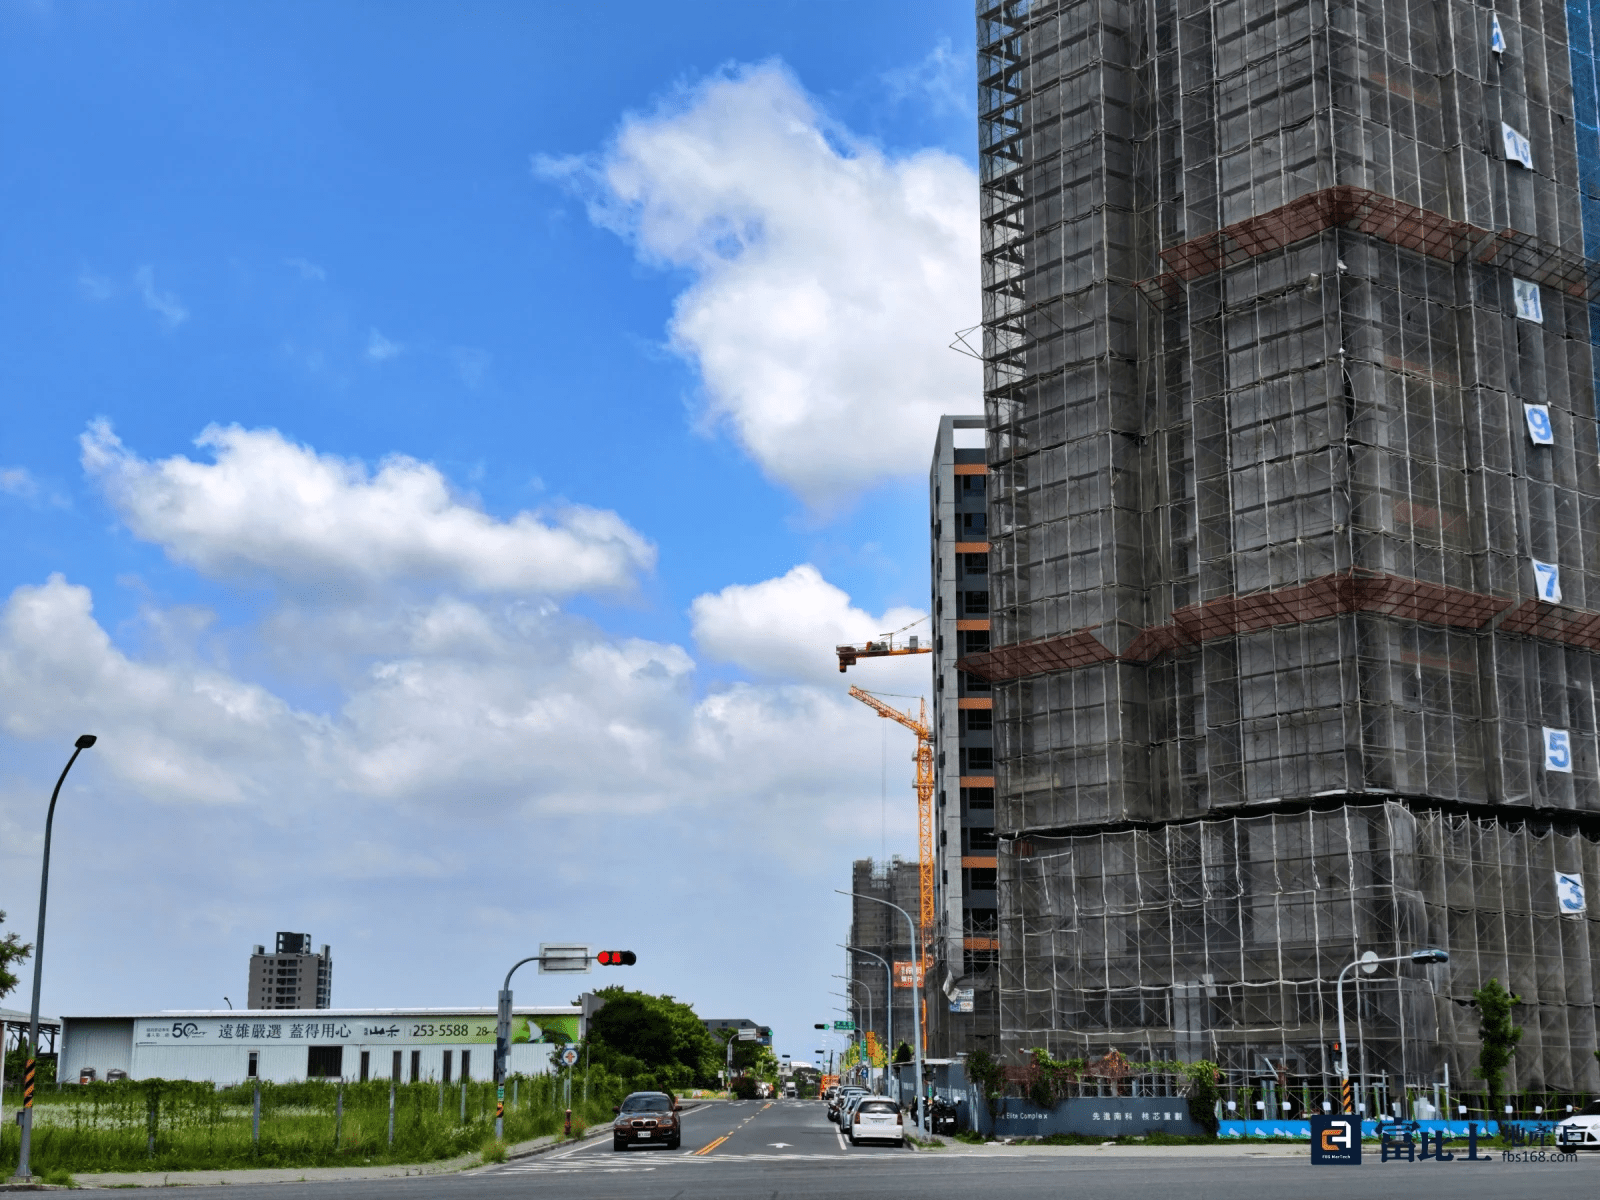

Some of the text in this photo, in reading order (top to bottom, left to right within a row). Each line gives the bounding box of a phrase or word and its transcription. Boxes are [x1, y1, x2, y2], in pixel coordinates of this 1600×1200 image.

[1516, 283, 1541, 319] 11
[1527, 407, 1552, 441] 9
[1535, 563, 1558, 598] 7
[1548, 732, 1570, 768] 5
[1560, 875, 1583, 910] 3
[172, 1022, 198, 1038] 50
[218, 1023, 282, 1039] 遠雄嚴選
[289, 1023, 352, 1039] 蓋得用心
[412, 1024, 469, 1037] 253-5588
[1020, 1112, 1048, 1121] Complex
